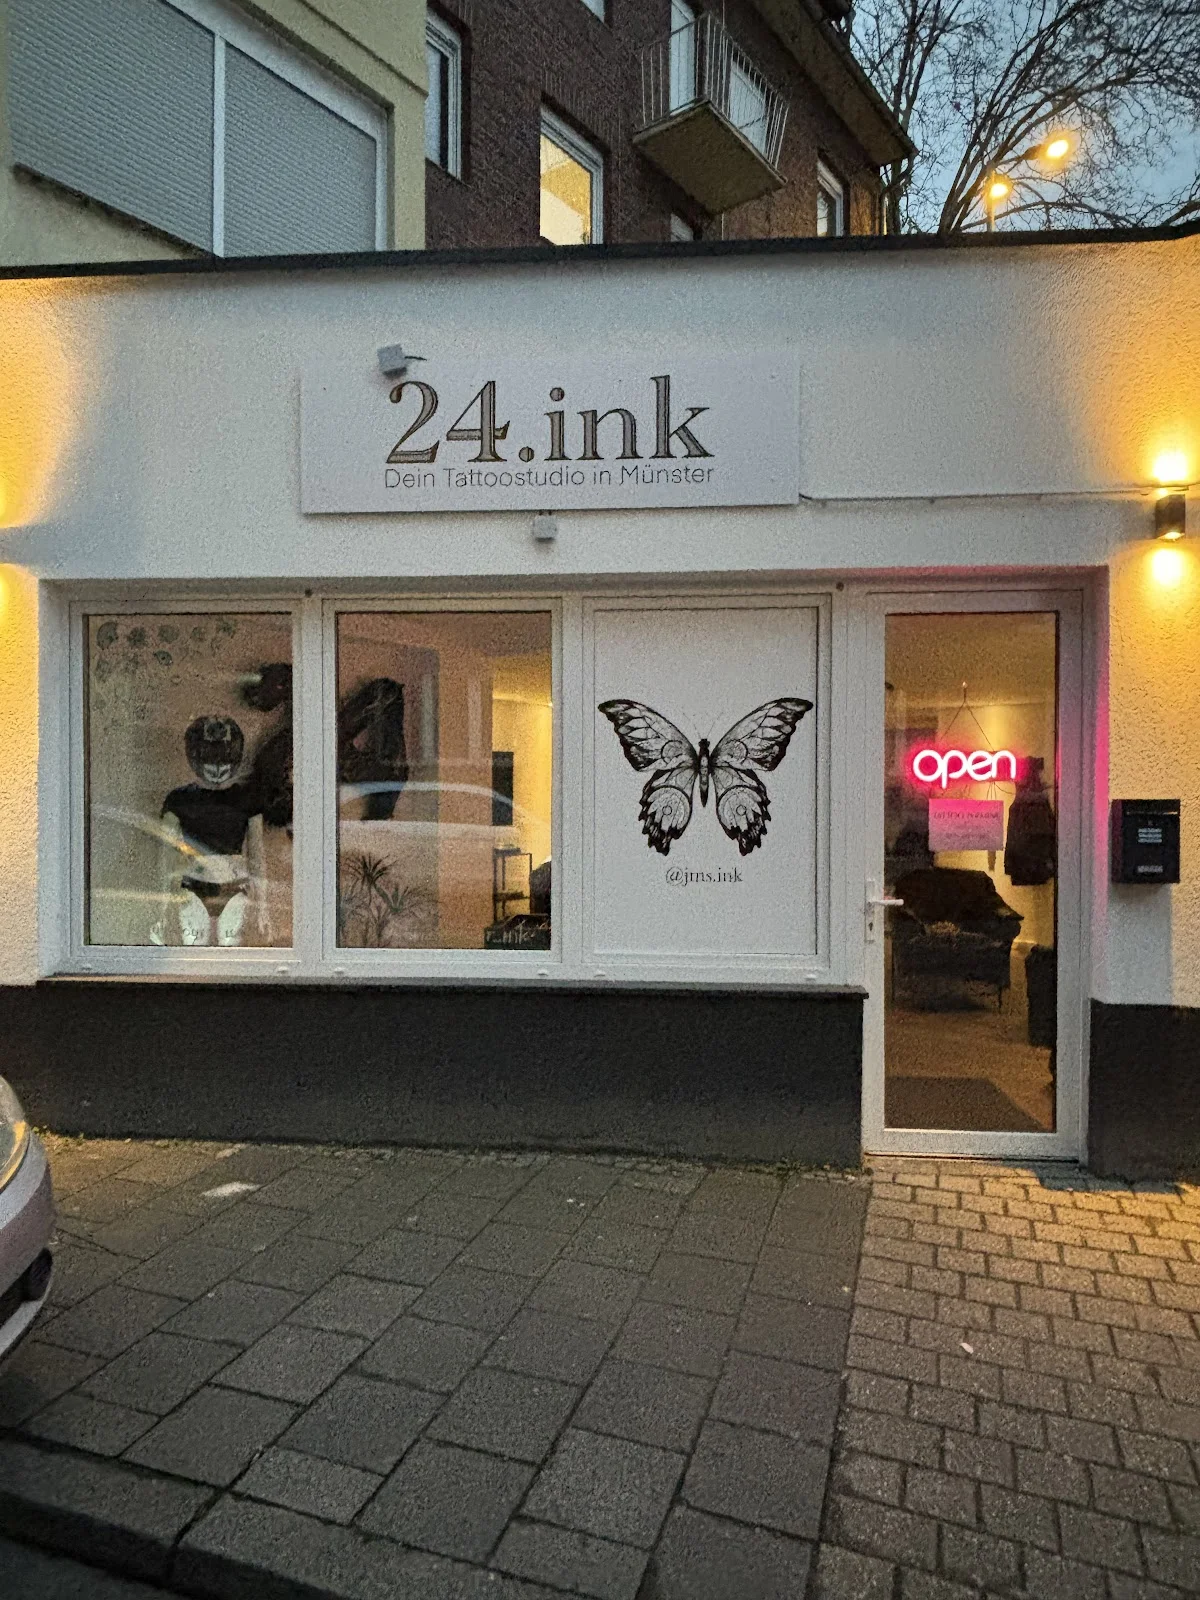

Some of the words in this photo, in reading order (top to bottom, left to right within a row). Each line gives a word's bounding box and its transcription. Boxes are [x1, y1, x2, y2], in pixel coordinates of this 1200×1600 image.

[385, 374, 715, 464] 24.ink
[384, 468, 436, 489] Dein
[443, 465, 585, 488] Tattoostudio
[593, 464, 612, 486] in
[620, 462, 715, 486] Münster
[913, 749, 1017, 789] open
[665, 866, 743, 887] @jms.ink
